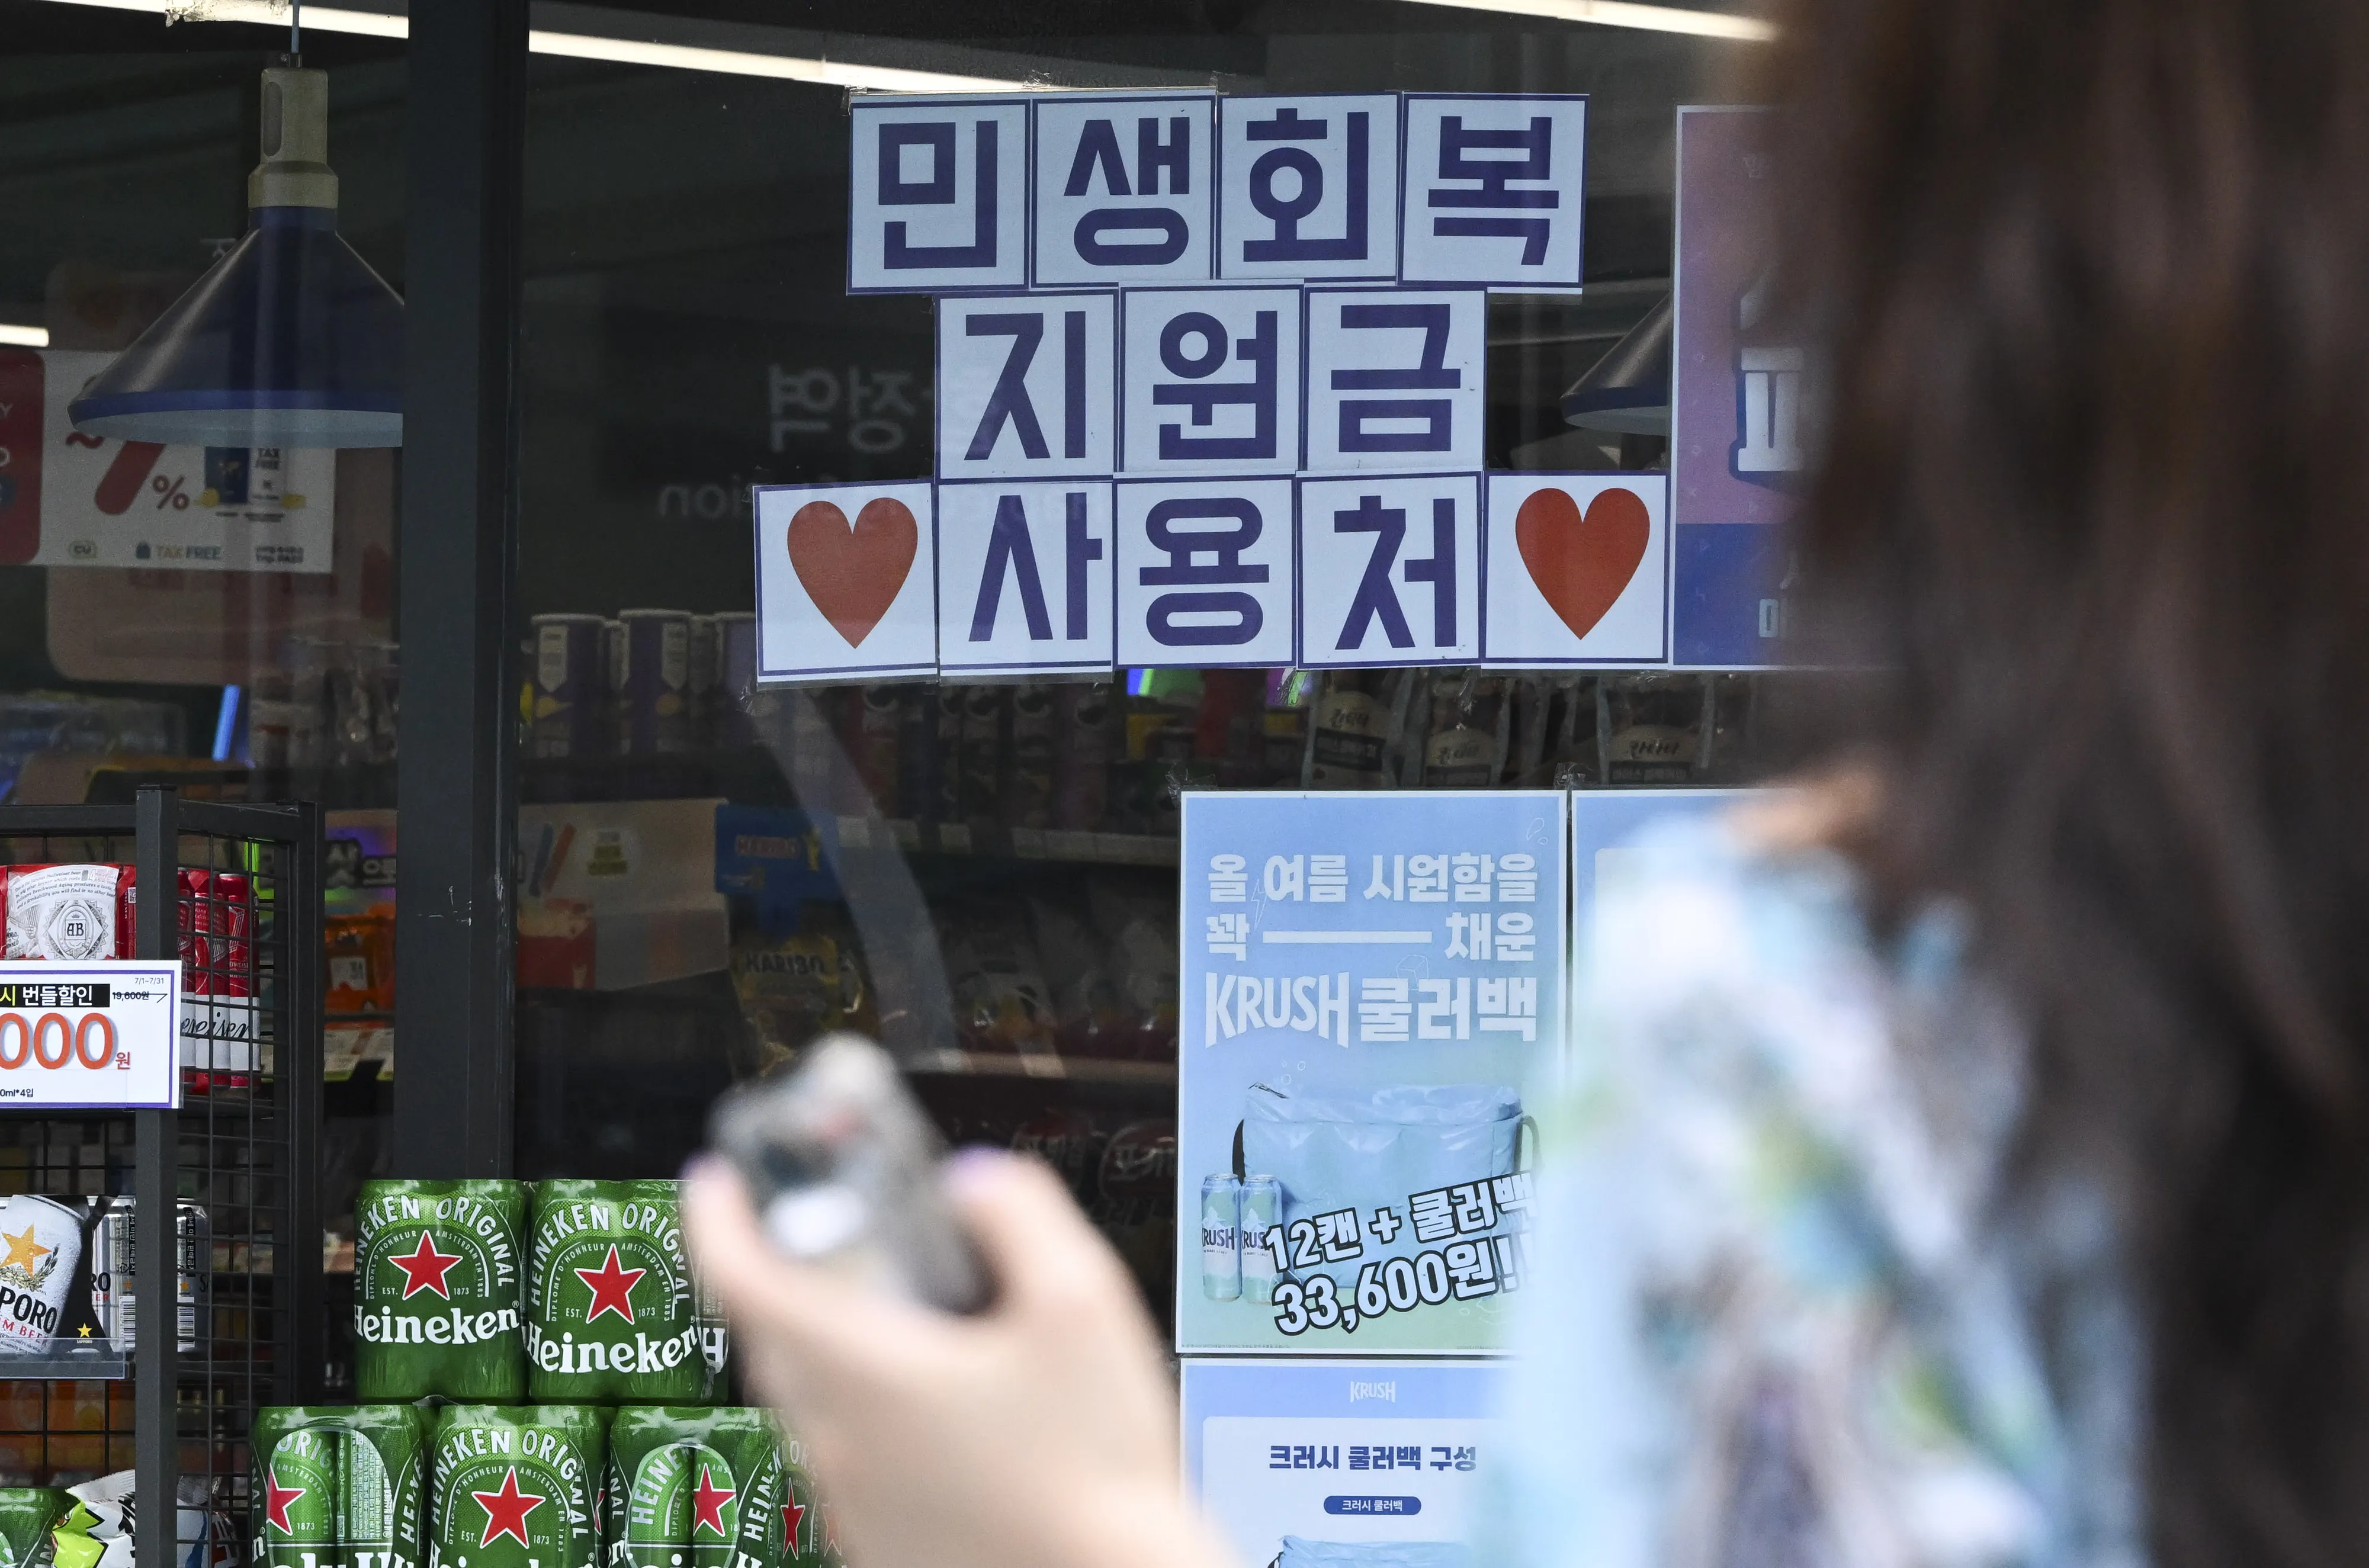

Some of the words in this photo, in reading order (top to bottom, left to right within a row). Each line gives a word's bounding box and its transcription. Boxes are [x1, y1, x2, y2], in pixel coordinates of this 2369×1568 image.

[878, 108, 1559, 268] 민생회복
[965, 304, 1460, 460] 지원금
[968, 492, 1456, 650] 사용처
[1208, 854, 1248, 902] 올
[1264, 854, 1349, 902] 여름
[1363, 852, 1537, 902] 시원함을
[66, 922, 84, 937] AB
[1444, 912, 1536, 961] 채운
[23, 985, 92, 1007] 번들할인
[1205, 972, 1349, 1049] KRUSH
[1358, 977, 1537, 1042] 쿨러백
[435, 1196, 515, 1287] ORIGINAL
[1263, 1207, 1363, 1273] 12캔
[1408, 1170, 1538, 1243] 쿨러백
[435, 1230, 477, 1259] AMSTERDAM
[531, 1204, 609, 1307] HEINEKEN
[621, 1243, 665, 1277] AMSTERDAM
[551, 1275, 561, 1322] DIPLOME
[566, 1307, 582, 1318] EST.
[638, 1307, 656, 1318] 1873
[354, 1304, 519, 1344] Heineken
[527, 1320, 698, 1373] Heineken
[1350, 1381, 1395, 1403] KRUSH
[432, 1429, 511, 1526] HEINEKEN
[1269, 1445, 1339, 1470] 크러시
[1348, 1446, 1421, 1470] 쿨러백
[1430, 1446, 1476, 1471] 구성
[519, 1466, 562, 1506] AMSTERDAM
[1342, 1499, 1371, 1512] 크러시
[1373, 1499, 1403, 1512] 쿨러백
[297, 1522, 315, 1530] 1873
[461, 1531, 477, 1543] EST.
[533, 1535, 550, 1544] 1873
